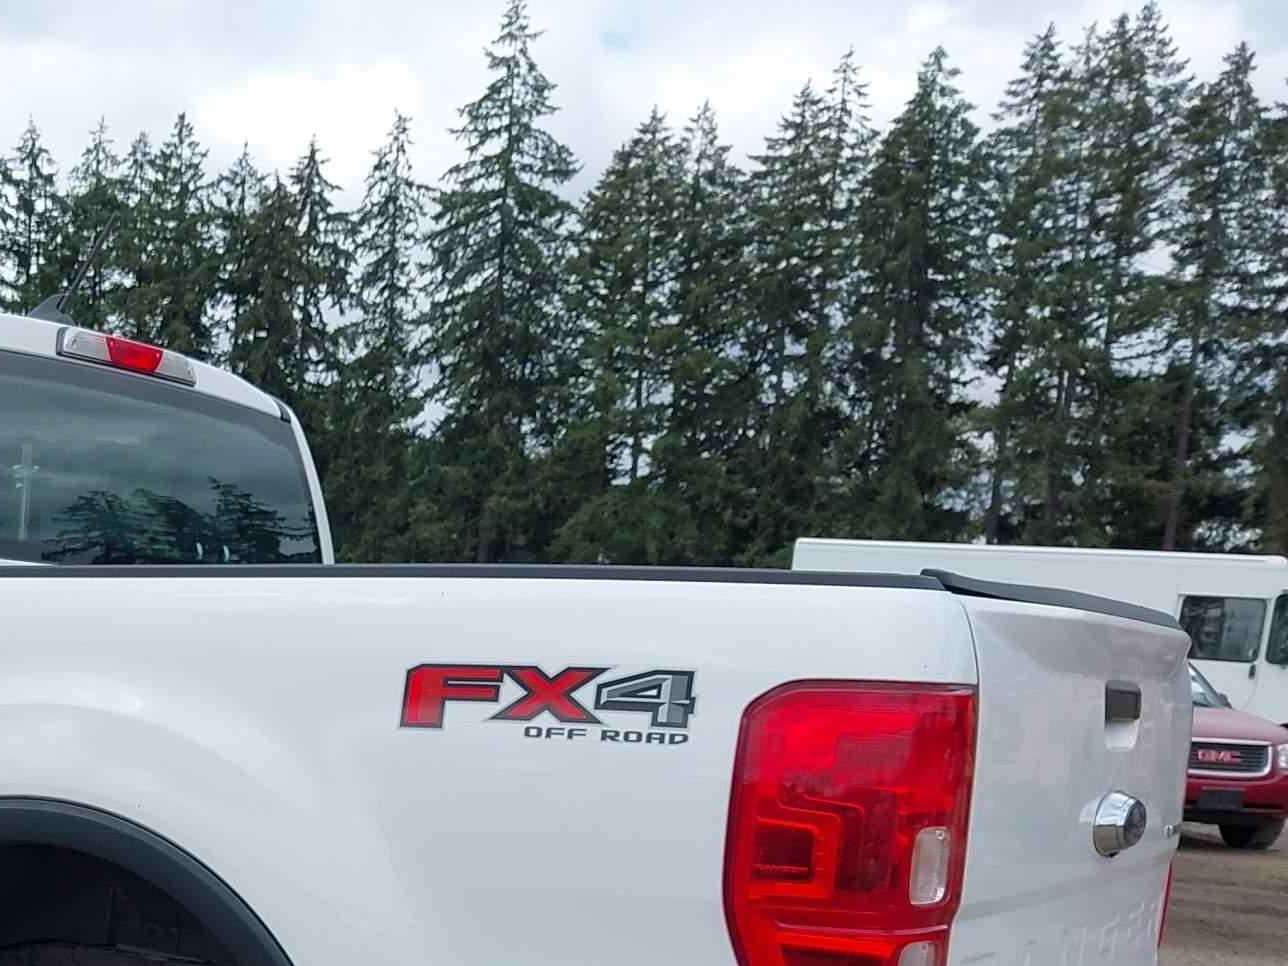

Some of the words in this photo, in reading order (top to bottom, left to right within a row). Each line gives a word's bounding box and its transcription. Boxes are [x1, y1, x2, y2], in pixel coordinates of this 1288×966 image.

[399, 662, 697, 729] FX4
[523, 726, 587, 741] OFF
[600, 729, 690, 745] ROAD
[1198, 749, 1241, 763] GMC
